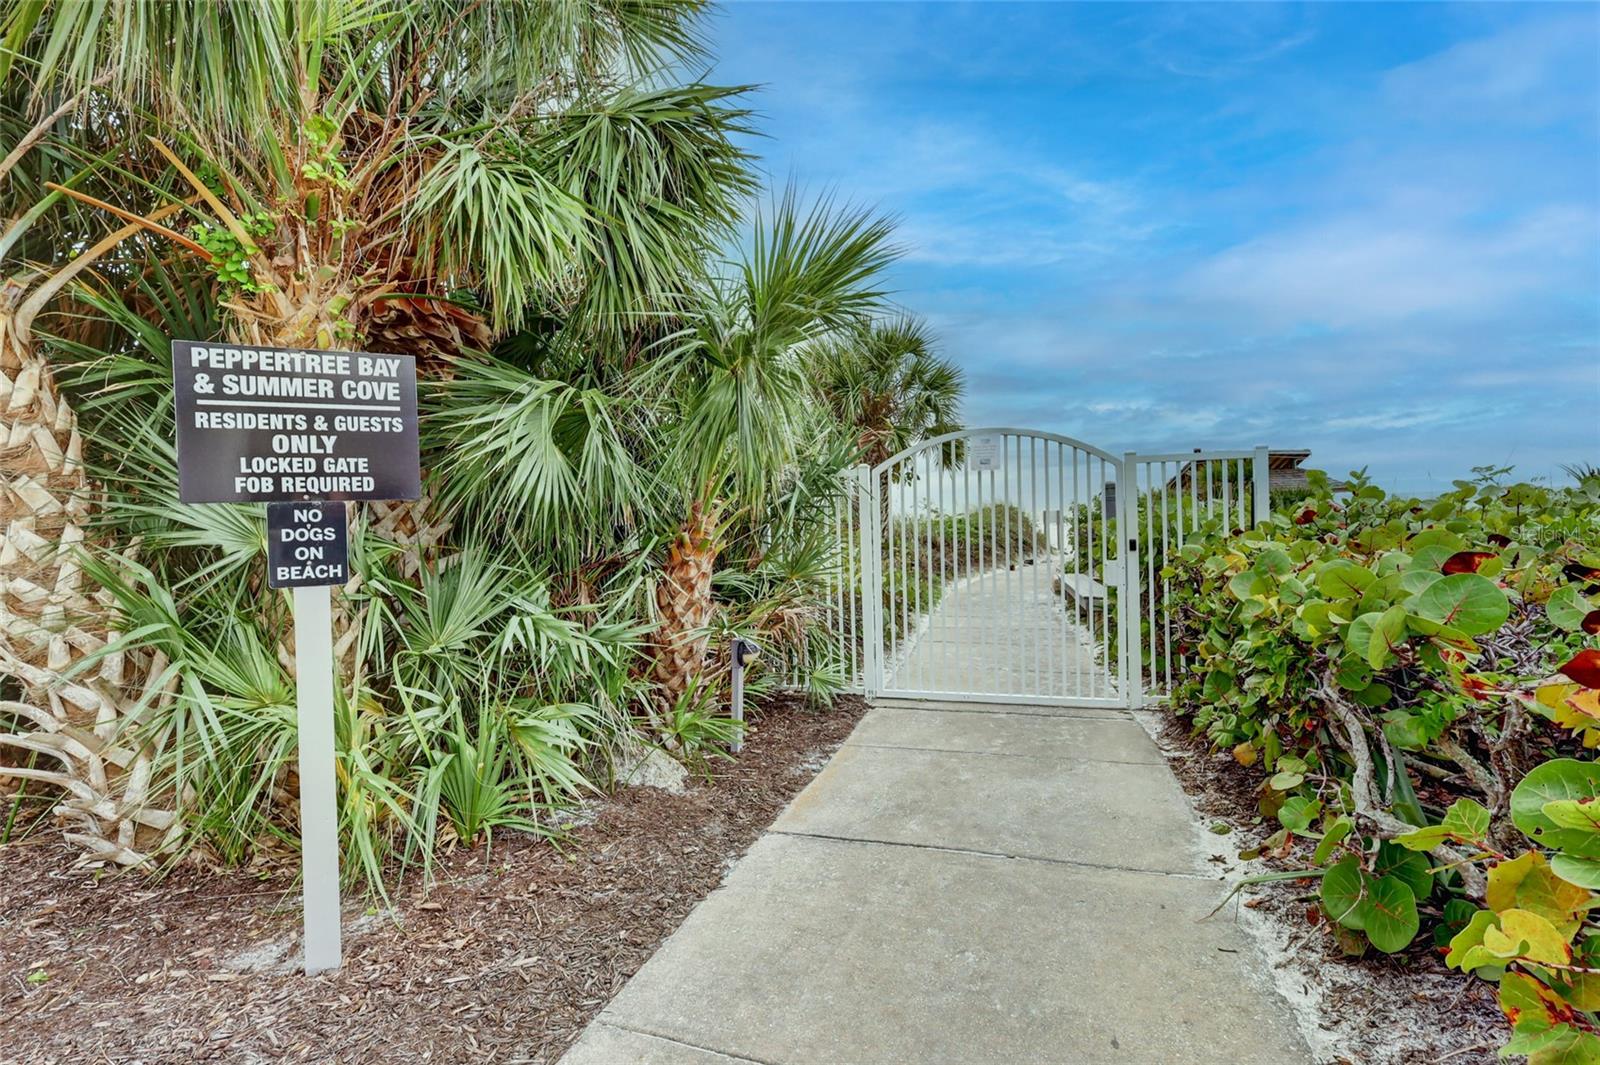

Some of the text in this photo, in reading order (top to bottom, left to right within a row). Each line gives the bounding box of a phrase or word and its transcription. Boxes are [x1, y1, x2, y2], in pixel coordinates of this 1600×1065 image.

[190, 347, 401, 377] PEPPERTREE BAY
[193, 373, 401, 401] & SUMMER COVE
[195, 411, 404, 433] RESIDENTS & GUESTS
[272, 434, 338, 454] ONLY
[240, 457, 369, 474] LOCKED GATE
[234, 476, 375, 494] FOB REQUIRED
[293, 509, 323, 523] NO
[281, 527, 336, 543] DOGS
[294, 547, 324, 561] ON
[276, 564, 343, 581] BEACH
